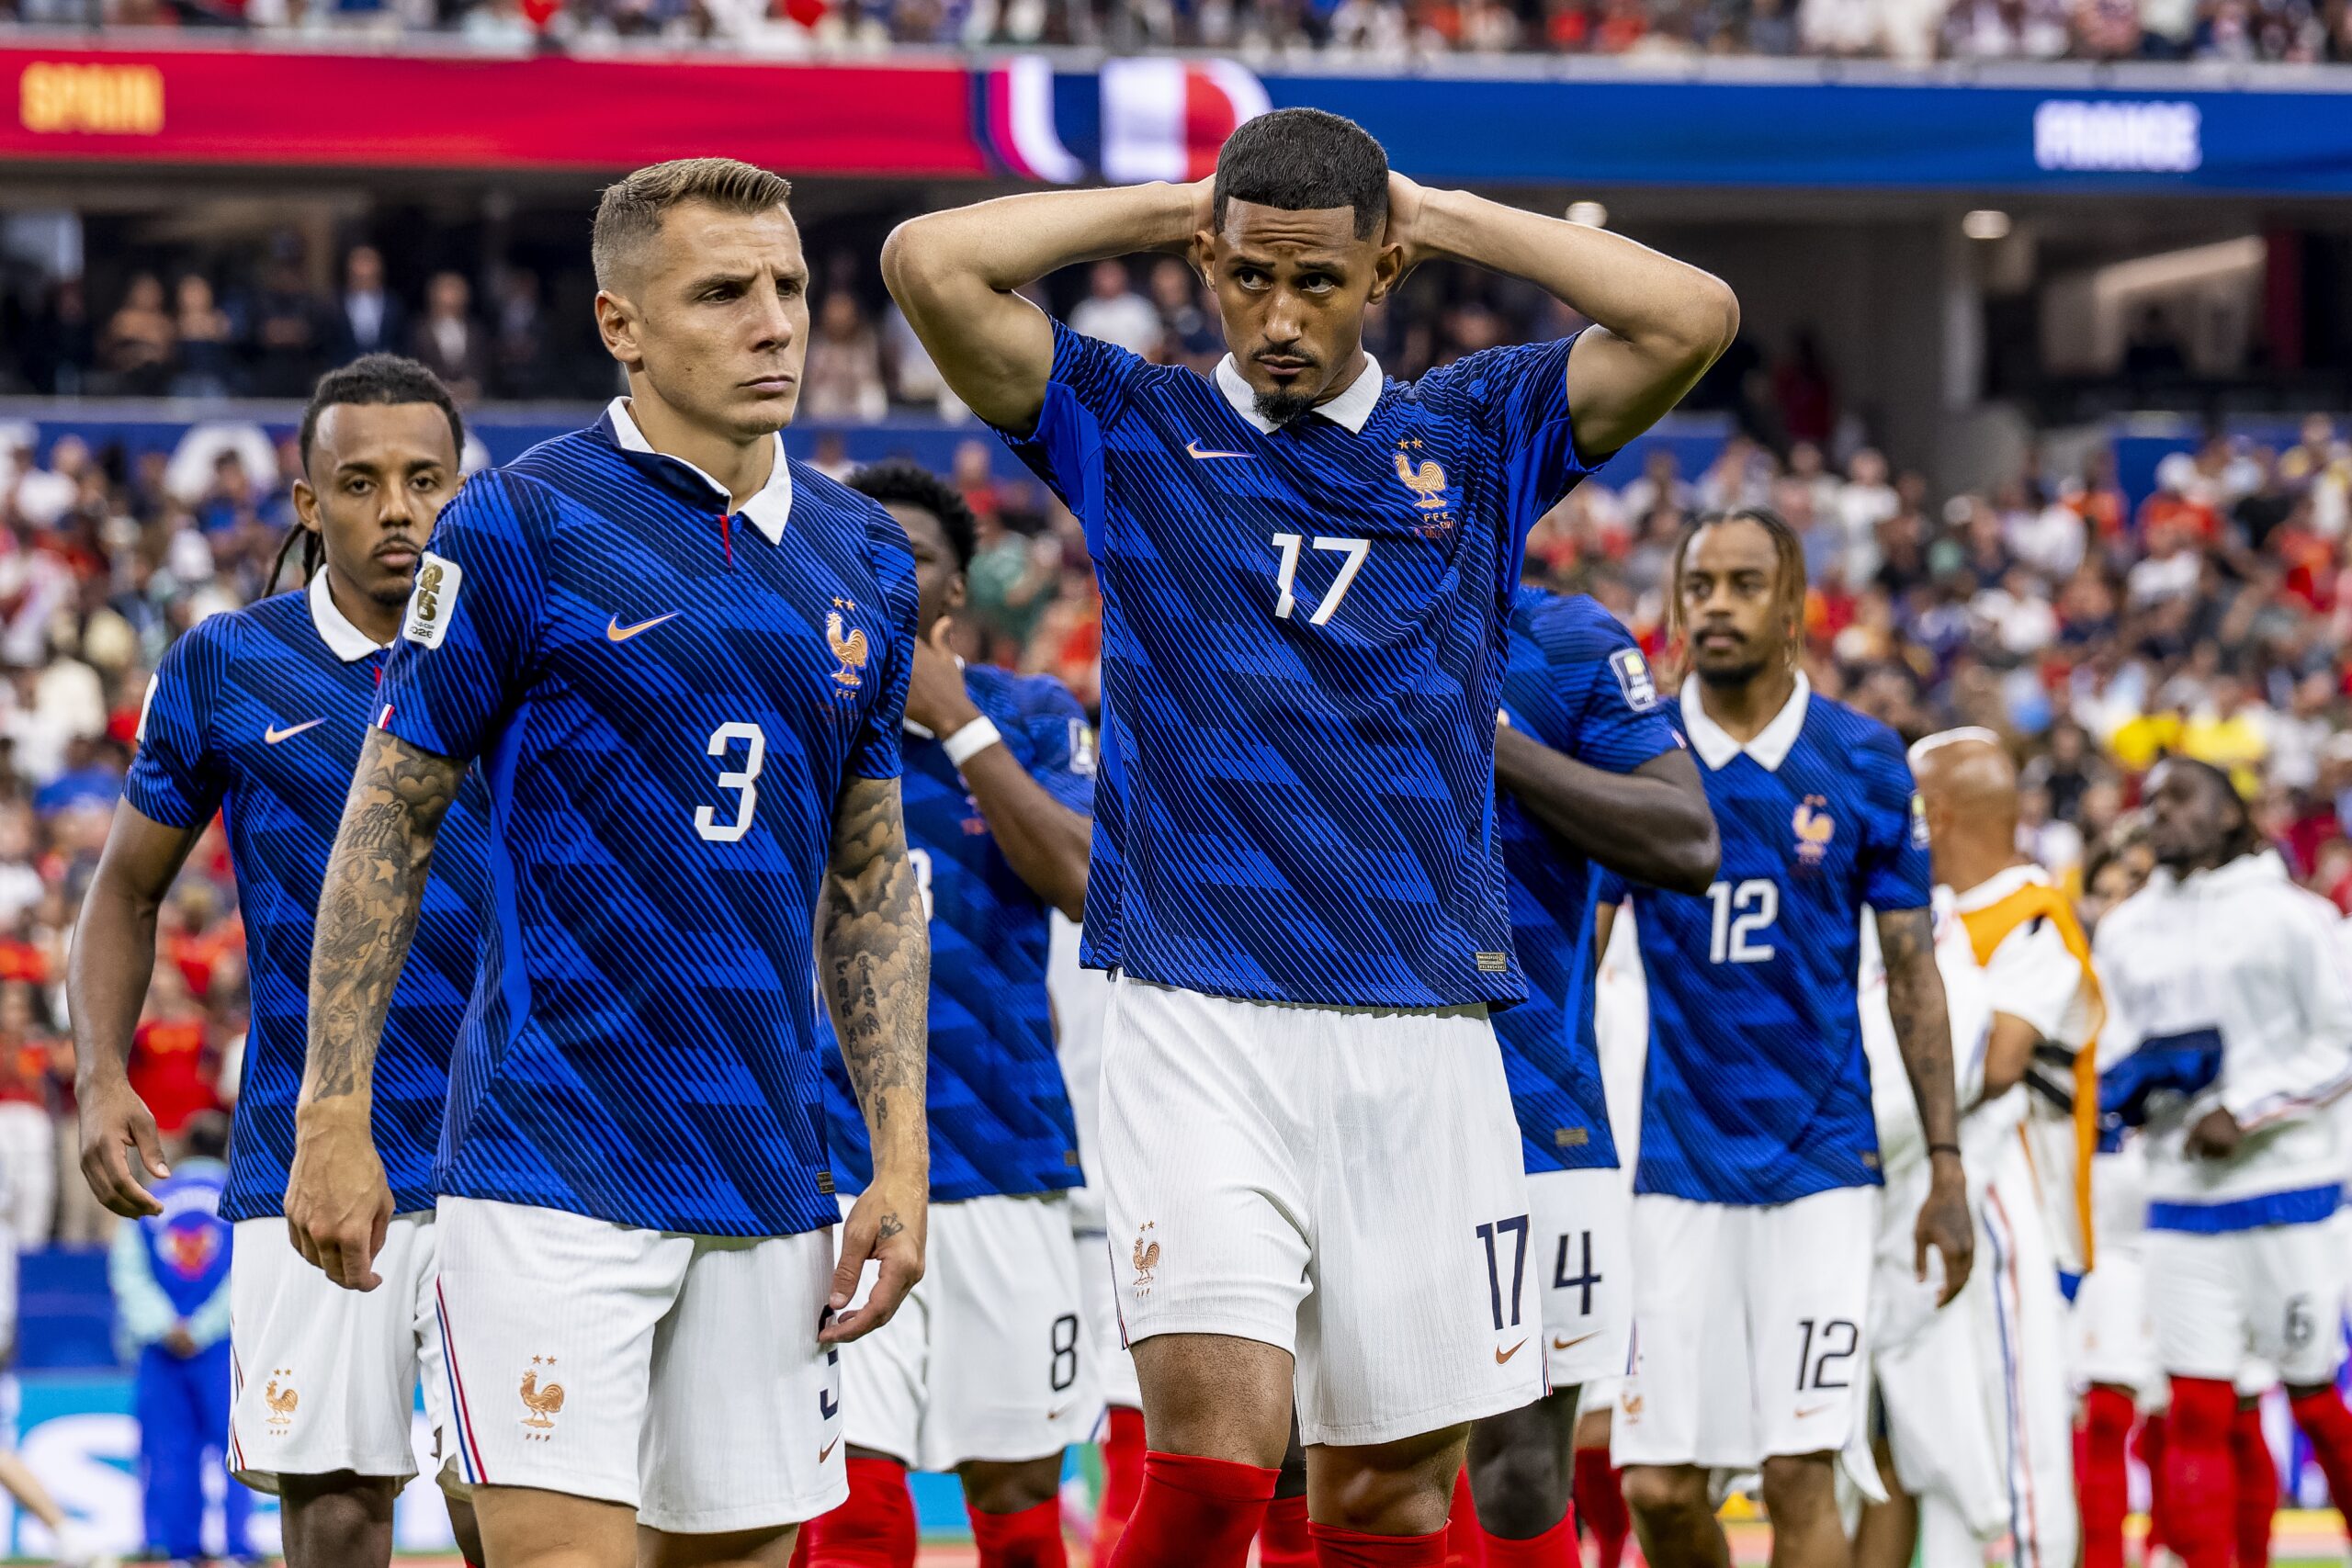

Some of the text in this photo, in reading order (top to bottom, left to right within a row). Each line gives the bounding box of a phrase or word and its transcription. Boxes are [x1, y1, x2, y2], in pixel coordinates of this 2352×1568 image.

[1272, 533, 1369, 626] 17
[695, 722, 765, 842] 3
[1705, 878, 1779, 964] 12
[1476, 1213, 1530, 1330] 17
[1553, 1230, 1601, 1315] 4
[1050, 1314, 1079, 1392] 8
[1795, 1320, 1859, 1391] 12
[2282, 1292, 2316, 1350] 6
